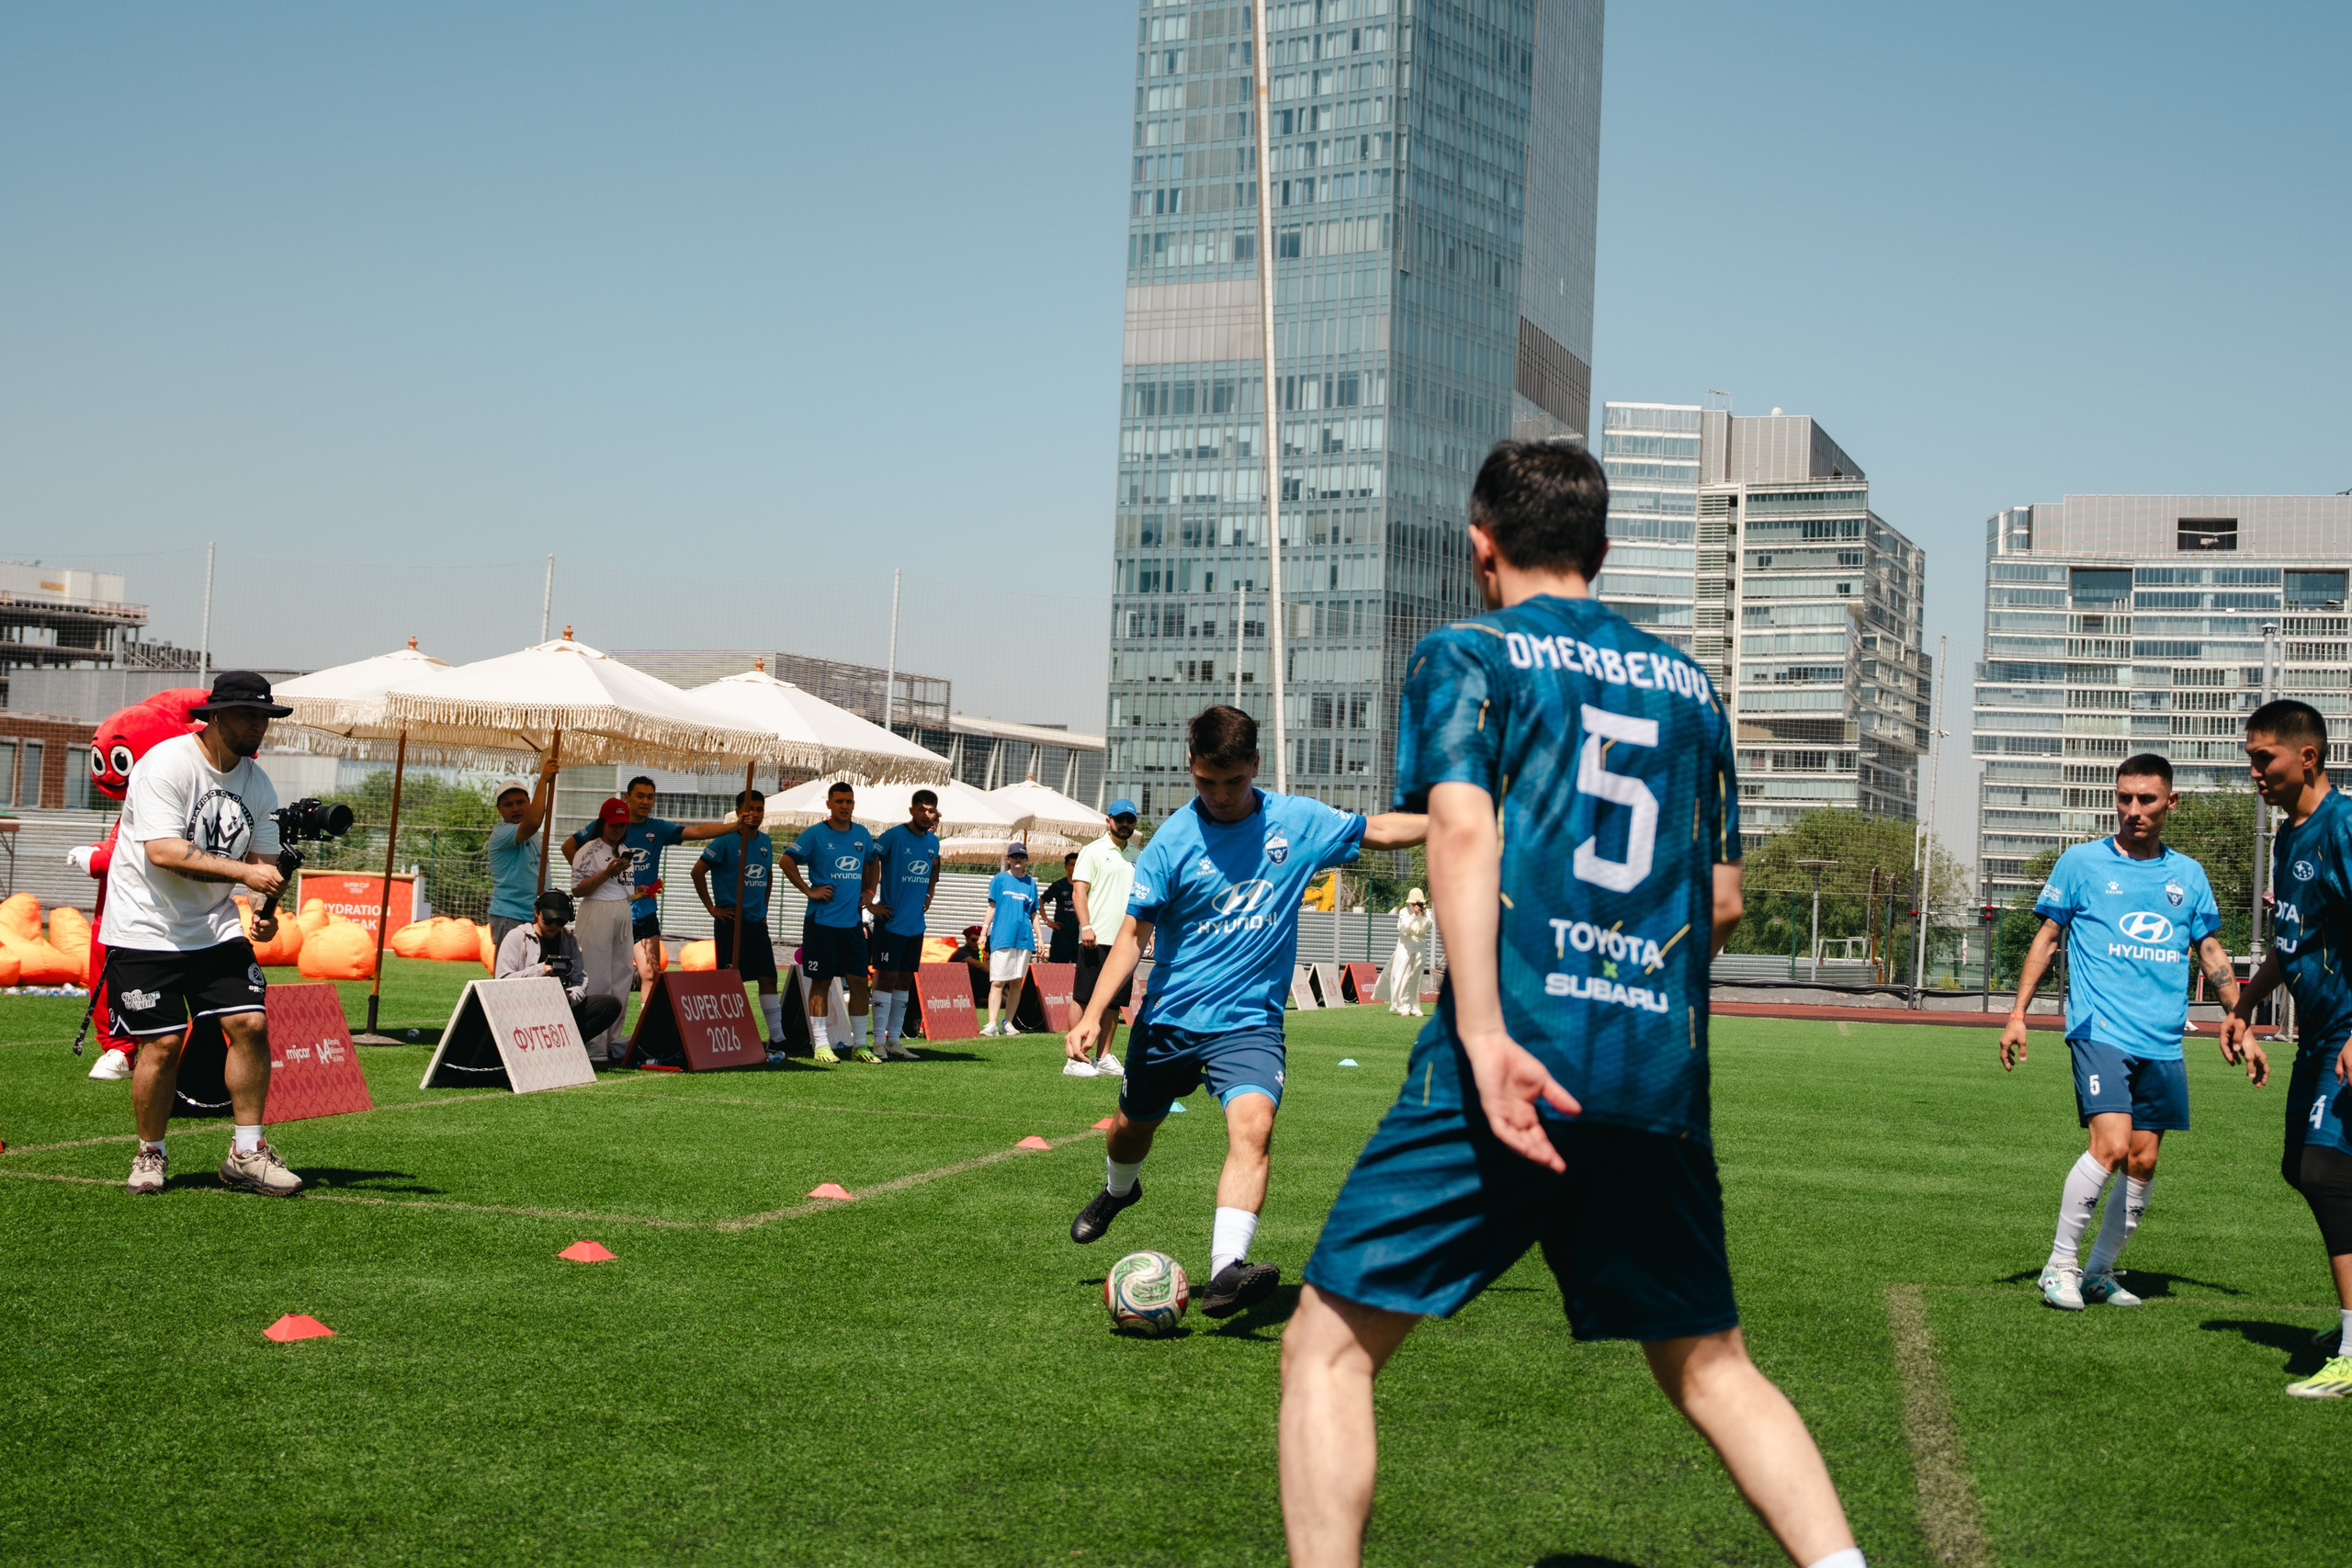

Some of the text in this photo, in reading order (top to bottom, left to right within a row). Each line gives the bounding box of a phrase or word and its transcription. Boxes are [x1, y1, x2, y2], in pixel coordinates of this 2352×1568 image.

[1505, 632, 1711, 705] OMERBEKOV
[1573, 703, 1659, 894] 5
[901, 875, 930, 884] HYUNDA
[1196, 911, 1277, 935] HYUNDAI
[1549, 919, 1665, 969] TOYOTA
[2109, 942, 2180, 964] HYUNDAI
[808, 961, 819, 971] 22
[681, 993, 745, 1021] SUPER CUP
[1545, 973, 1668, 1013] SUBARU
[513, 1023, 571, 1053] ФУТБОЛ
[707, 1025, 741, 1053] 2026
[2089, 1074, 2101, 1096] 5
